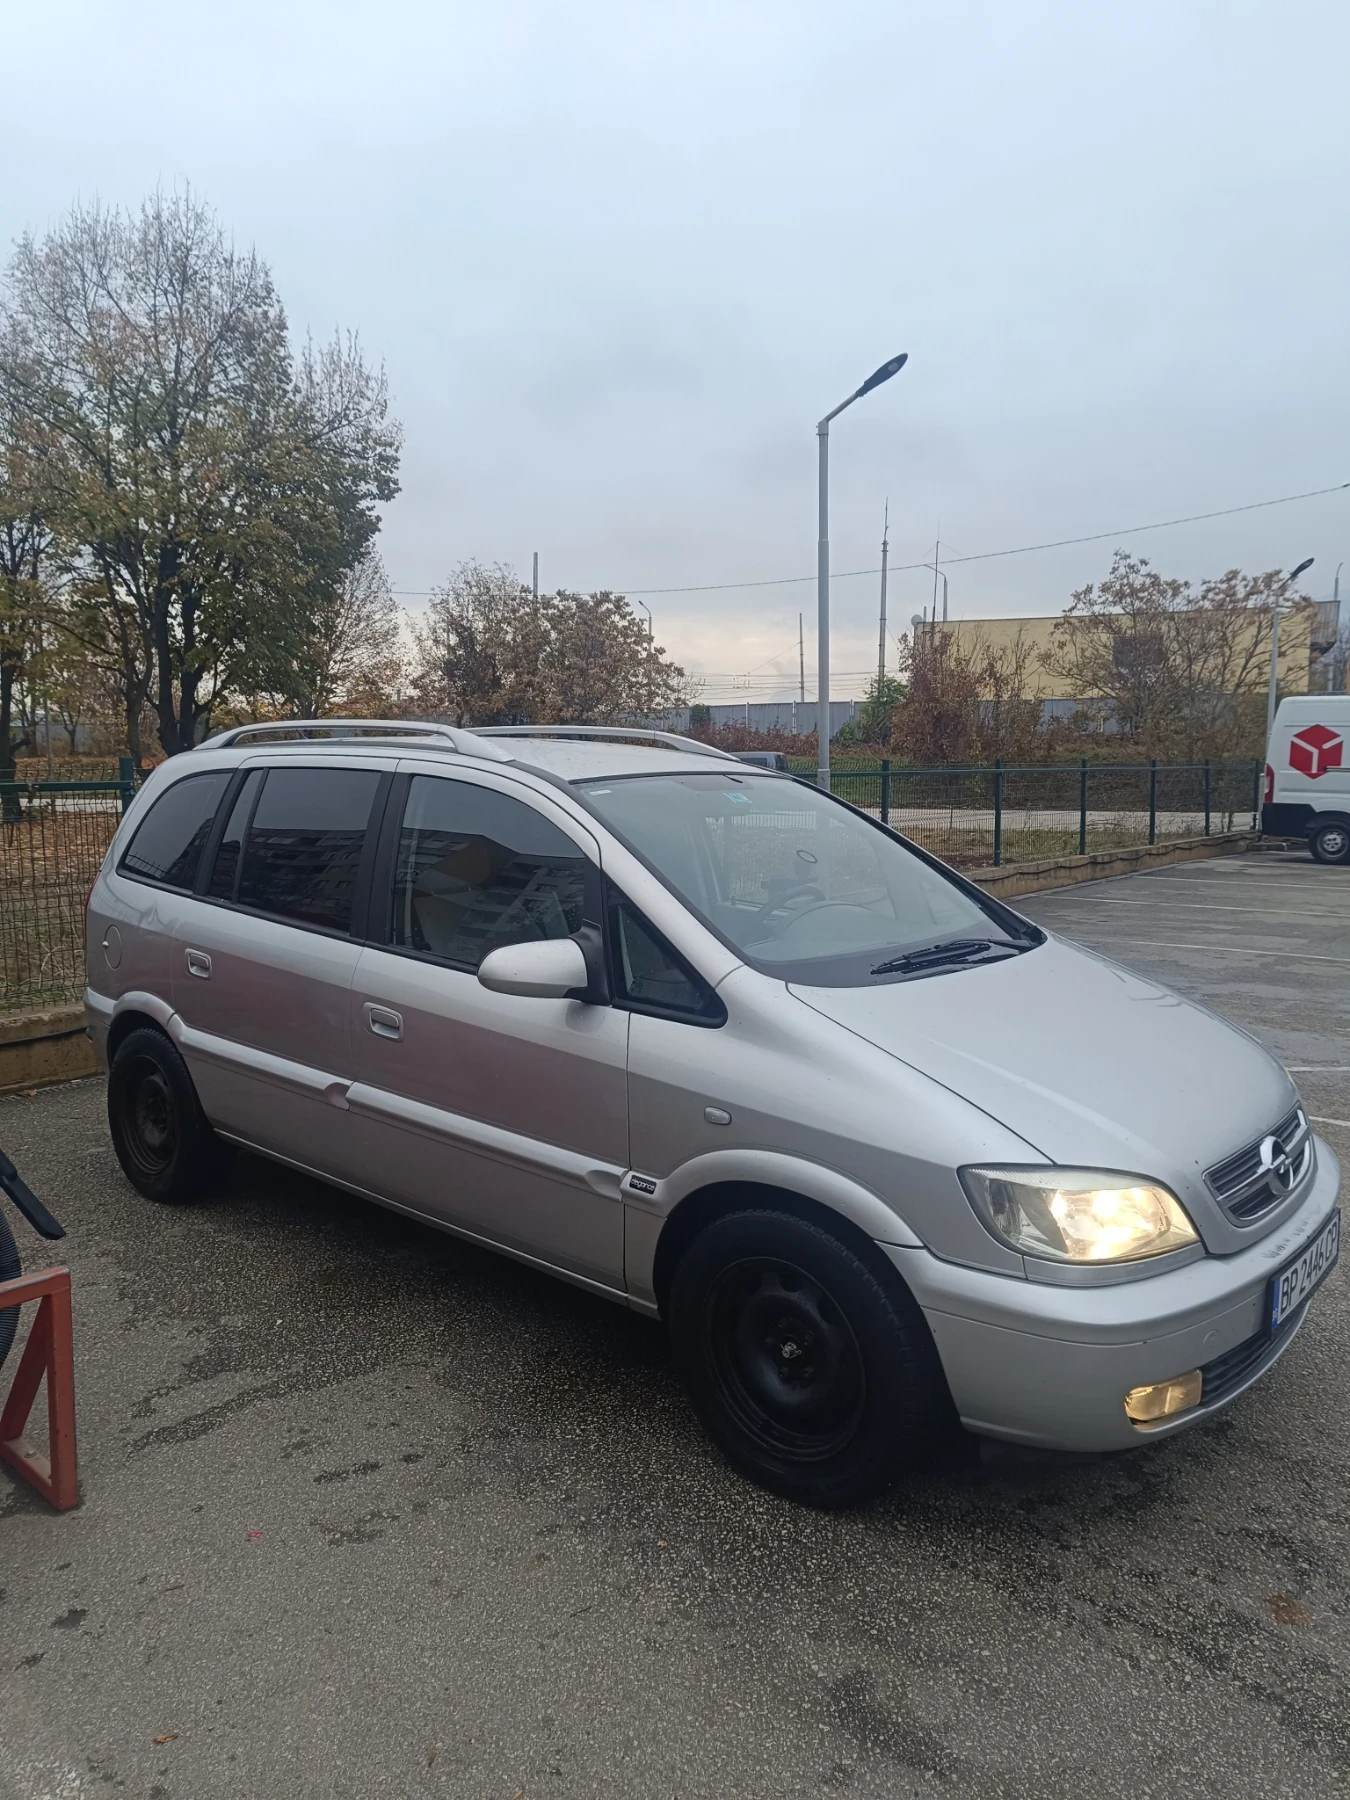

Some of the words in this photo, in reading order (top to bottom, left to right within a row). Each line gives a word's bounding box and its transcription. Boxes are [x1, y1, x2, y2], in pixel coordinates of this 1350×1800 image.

[1281, 1267, 1298, 1315] BP
[1299, 1237, 1324, 1296] 2446
[1325, 1220, 1338, 1263] CP
